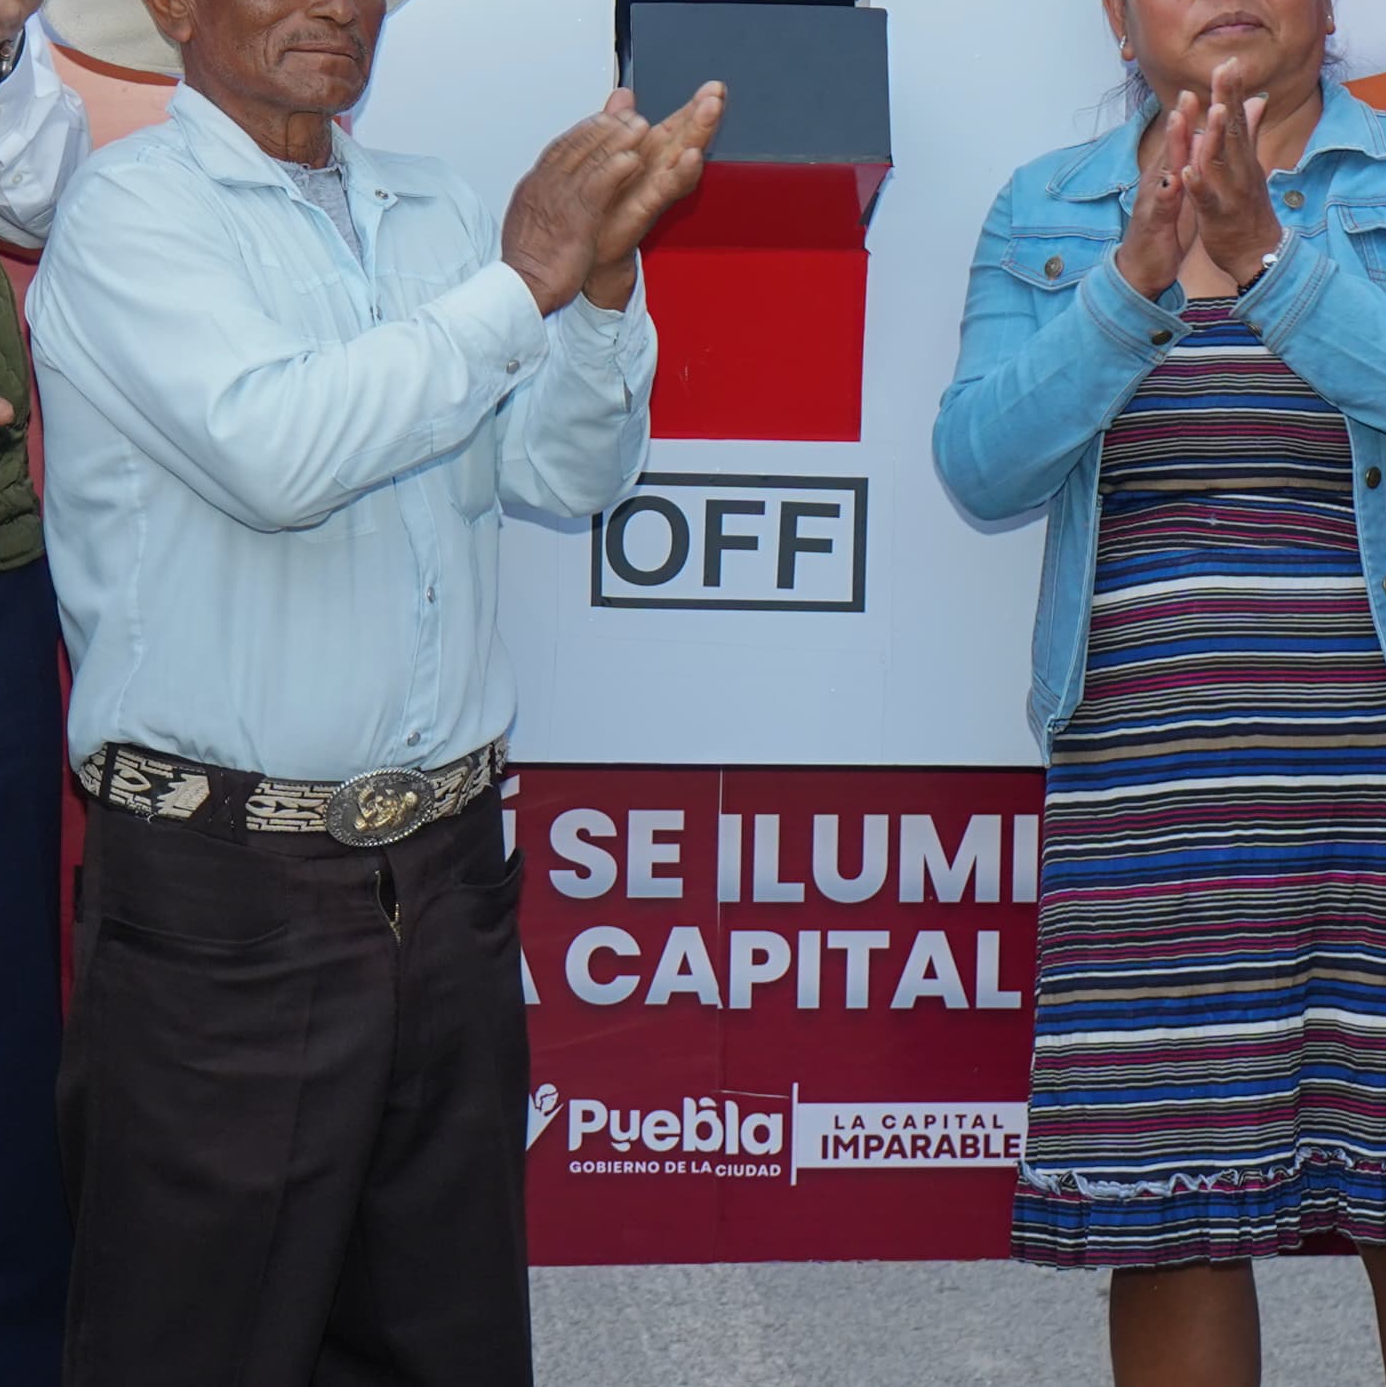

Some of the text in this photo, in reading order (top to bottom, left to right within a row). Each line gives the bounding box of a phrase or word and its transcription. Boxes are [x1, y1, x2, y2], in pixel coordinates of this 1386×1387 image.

[604, 494, 842, 590] OFF
[548, 808, 685, 899] SE
[718, 814, 1039, 904] ILUMI
[565, 925, 1022, 1009] CAPITAL
[568, 1096, 784, 1156] Puebla
[820, 1133, 1022, 1160] IMPARABLE
[834, 1114, 1005, 1130] LA CAPITAL
[569, 1161, 782, 1178] GOBIERNO DE LA CIUDAD
